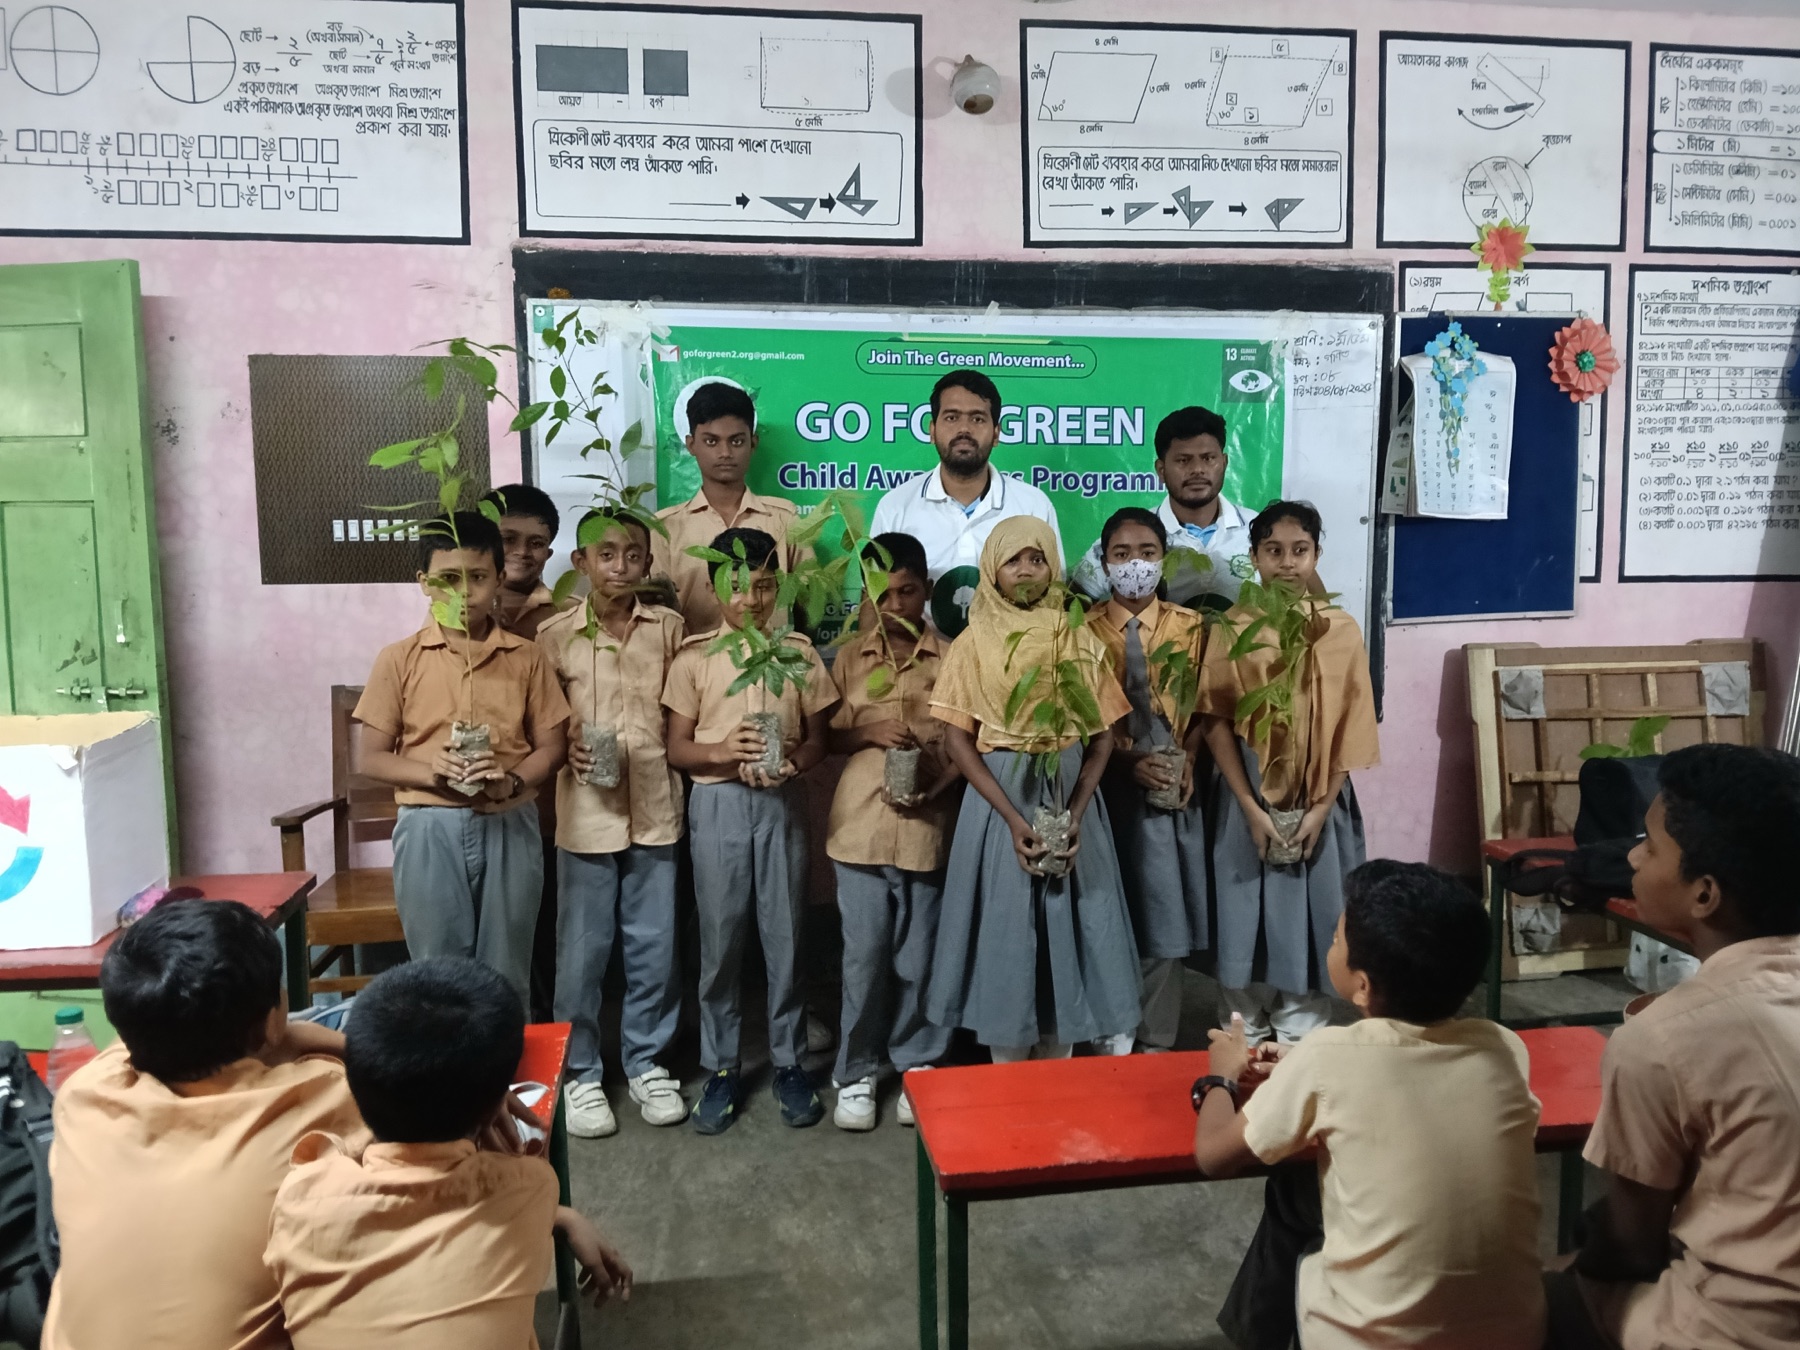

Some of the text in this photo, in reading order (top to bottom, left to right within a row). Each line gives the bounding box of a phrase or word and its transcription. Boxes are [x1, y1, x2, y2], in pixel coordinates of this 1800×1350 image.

[398, 122, 422, 136] করা
[614, 134, 658, 149] ব্যবহার
[662, 135, 690, 150] করে
[695, 137, 734, 152] আমরা
[738, 139, 768, 153] পাশে
[770, 139, 812, 155] দেখানো
[548, 150, 584, 169] ছবির
[588, 156, 616, 171] মতো
[645, 154, 683, 173] আঁকতে
[1102, 156, 1139, 171] ব্যবহার
[1141, 157, 1165, 171] করে
[1168, 157, 1200, 172] আমরা
[1254, 154, 1278, 173] ছবির
[1042, 176, 1069, 190] রেখা
[1733, 280, 1772, 296] ভগ্নাংশ
[683, 349, 805, 361] goforgreen2.org@gmail.com
[867, 350, 901, 365] Join
[905, 351, 934, 366] The
[937, 351, 985, 366] Green
[1225, 348, 1237, 361] 13
[795, 401, 1144, 446] GO FO GREEN
[778, 462, 858, 490] Child
